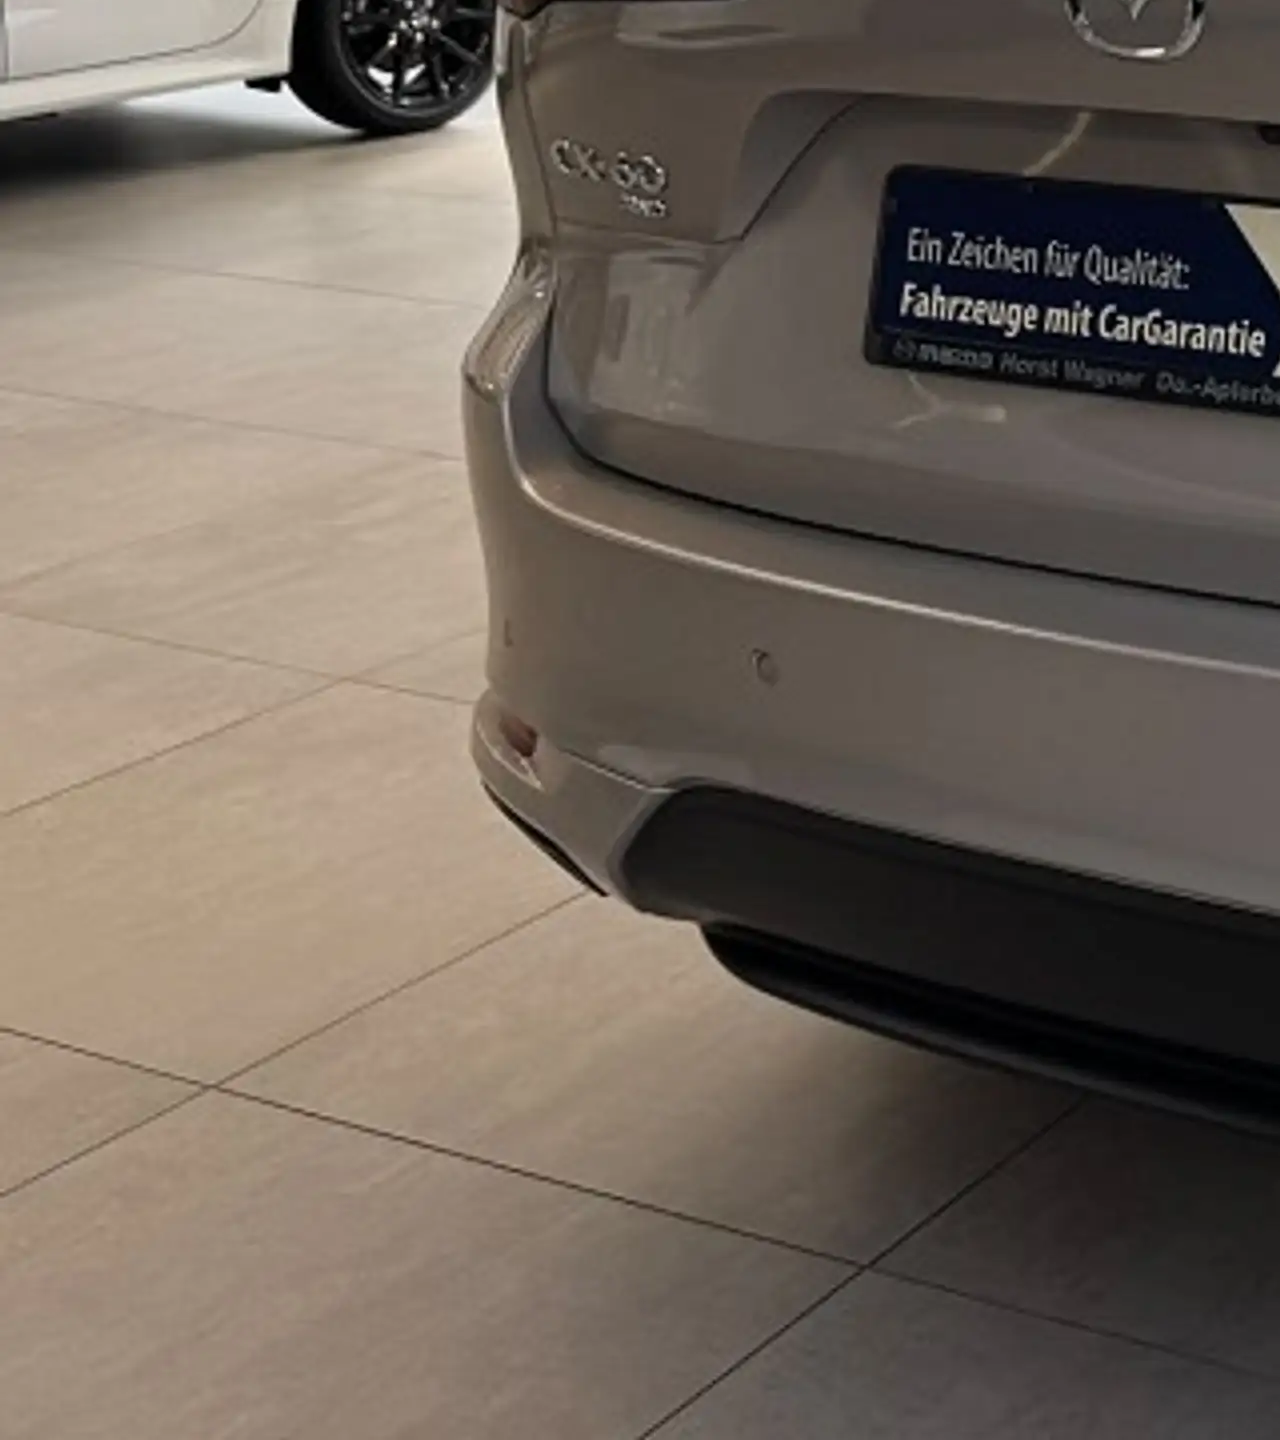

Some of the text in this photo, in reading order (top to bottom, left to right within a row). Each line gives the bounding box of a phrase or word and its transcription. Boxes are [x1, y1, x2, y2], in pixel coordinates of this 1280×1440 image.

[906, 227, 1191, 291] Ein Zeichen für Qualität:
[899, 282, 1265, 357] Fahrzeuge mit CarGarantie
[999, 351, 1058, 379] Horst
[1064, 358, 1145, 389] Wagner
